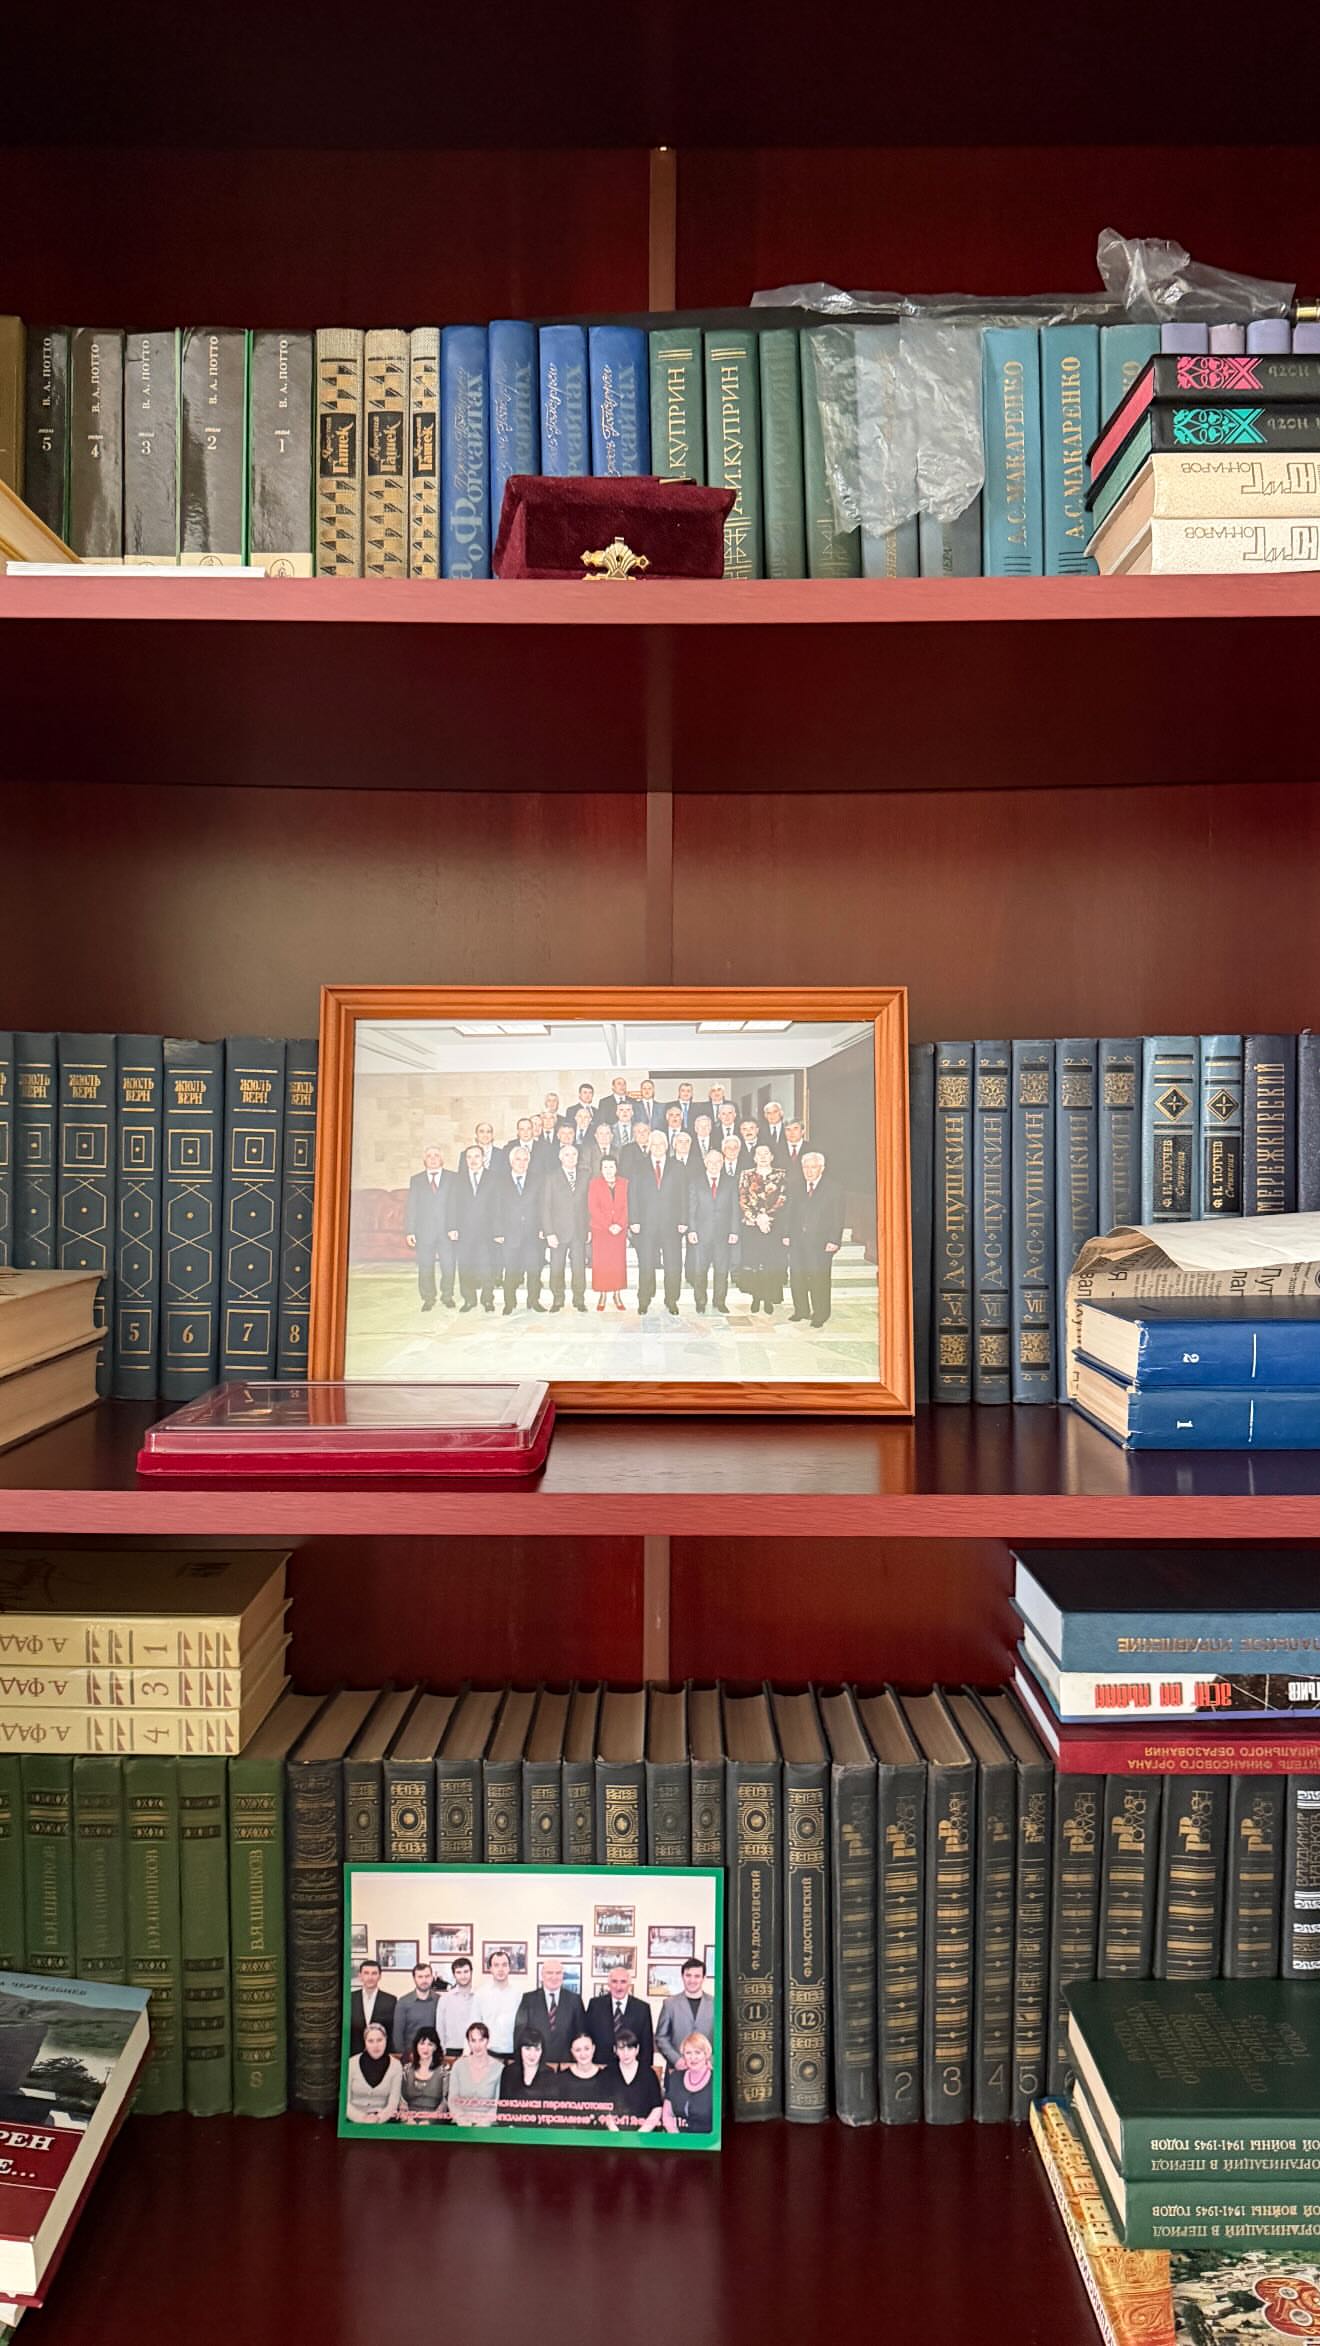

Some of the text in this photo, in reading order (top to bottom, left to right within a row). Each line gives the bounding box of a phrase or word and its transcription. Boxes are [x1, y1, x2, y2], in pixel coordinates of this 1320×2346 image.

[42, 337, 52, 378] ПОТТО
[142, 340, 150, 380] ПОТТО
[209, 335, 219, 376] ПОТТО
[280, 340, 288, 380] ПОТТО
[91, 344, 100, 384] ПОТТО
[43, 437, 52, 451] 5
[142, 440, 151, 455] 3
[208, 436, 217, 450] 2
[280, 438, 286, 453] 1
[91, 444, 98, 458] 4
[1254, 1063, 1285, 1212] МЕРЕЖКОВСКИЙ
[129, 1323, 140, 1342] 5
[182, 1324, 194, 1344] 6
[243, 1323, 254, 1342] 7
[289, 1324, 300, 1343] 8
[1184, 1352, 1200, 1363] 2
[1177, 1420, 1192, 1430] 1
[144, 1644, 168, 1654] 1
[142, 1682, 168, 1697] 3
[143, 1728, 170, 1744] 4
[1144, 1746, 1234, 1756] ОБРАЗОВАНИЯ
[1128, 1759, 1174, 1770] ОРГАНА
[1176, 1759, 1273, 1769] ФИНАНСОВОГО
[1296, 1812, 1309, 1887] ВЛАДИМИР
[749, 2005, 761, 2020] 11
[800, 2012, 815, 2026] 12
[859, 2072, 864, 2098] 1
[895, 2072, 912, 2100] 2
[944, 2066, 961, 2096] 3
[989, 2065, 1003, 2092] 4
[1018, 2067, 1038, 2094] 5
[1150, 2138, 1190, 2150] ГОДОВ
[1194, 2139, 1245, 2150] 1941-1945
[1250, 2139, 1296, 2151] ВОЙНЫ
[1151, 2159, 1206, 2170] ПЕРИОД
[1210, 2160, 1218, 2170] В
[1152, 2205, 1191, 2216] ГОДОВ
[1196, 2206, 1246, 2217] 1941-1945
[1252, 2205, 1298, 2218] ВОЙНЫ
[1153, 2225, 1208, 2237] ПЕРИОД
[1211, 2226, 1220, 2236] В
